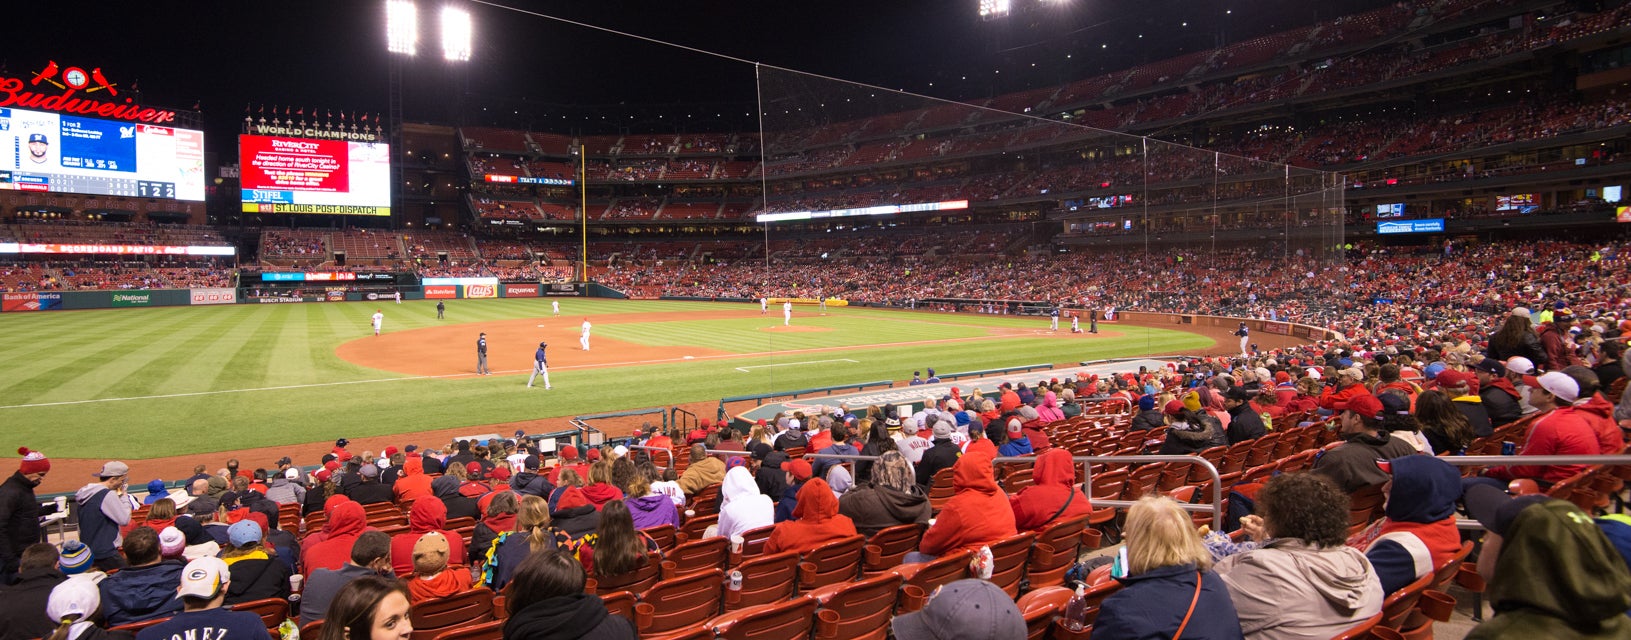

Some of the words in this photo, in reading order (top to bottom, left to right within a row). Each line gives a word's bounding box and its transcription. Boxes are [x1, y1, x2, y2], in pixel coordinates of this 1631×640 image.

[0, 77, 174, 123] Budweiser
[257, 125, 302, 136] WORLD
[305, 128, 375, 142] CHAMPIONS
[294, 162, 318, 170] RiverCity
[140, 186, 146, 196] 1
[152, 188, 160, 196] 2
[166, 188, 174, 198] 2
[253, 190, 283, 200] STIFEL
[290, 204, 313, 212] LOUIS
[316, 206, 377, 214] POST-DISPATCH
[60, 246, 124, 254] SCOREBOARD
[127, 246, 154, 254] PATIO
[468, 284, 494, 298] Lay's
[908, 440, 930, 450] MOLINA
